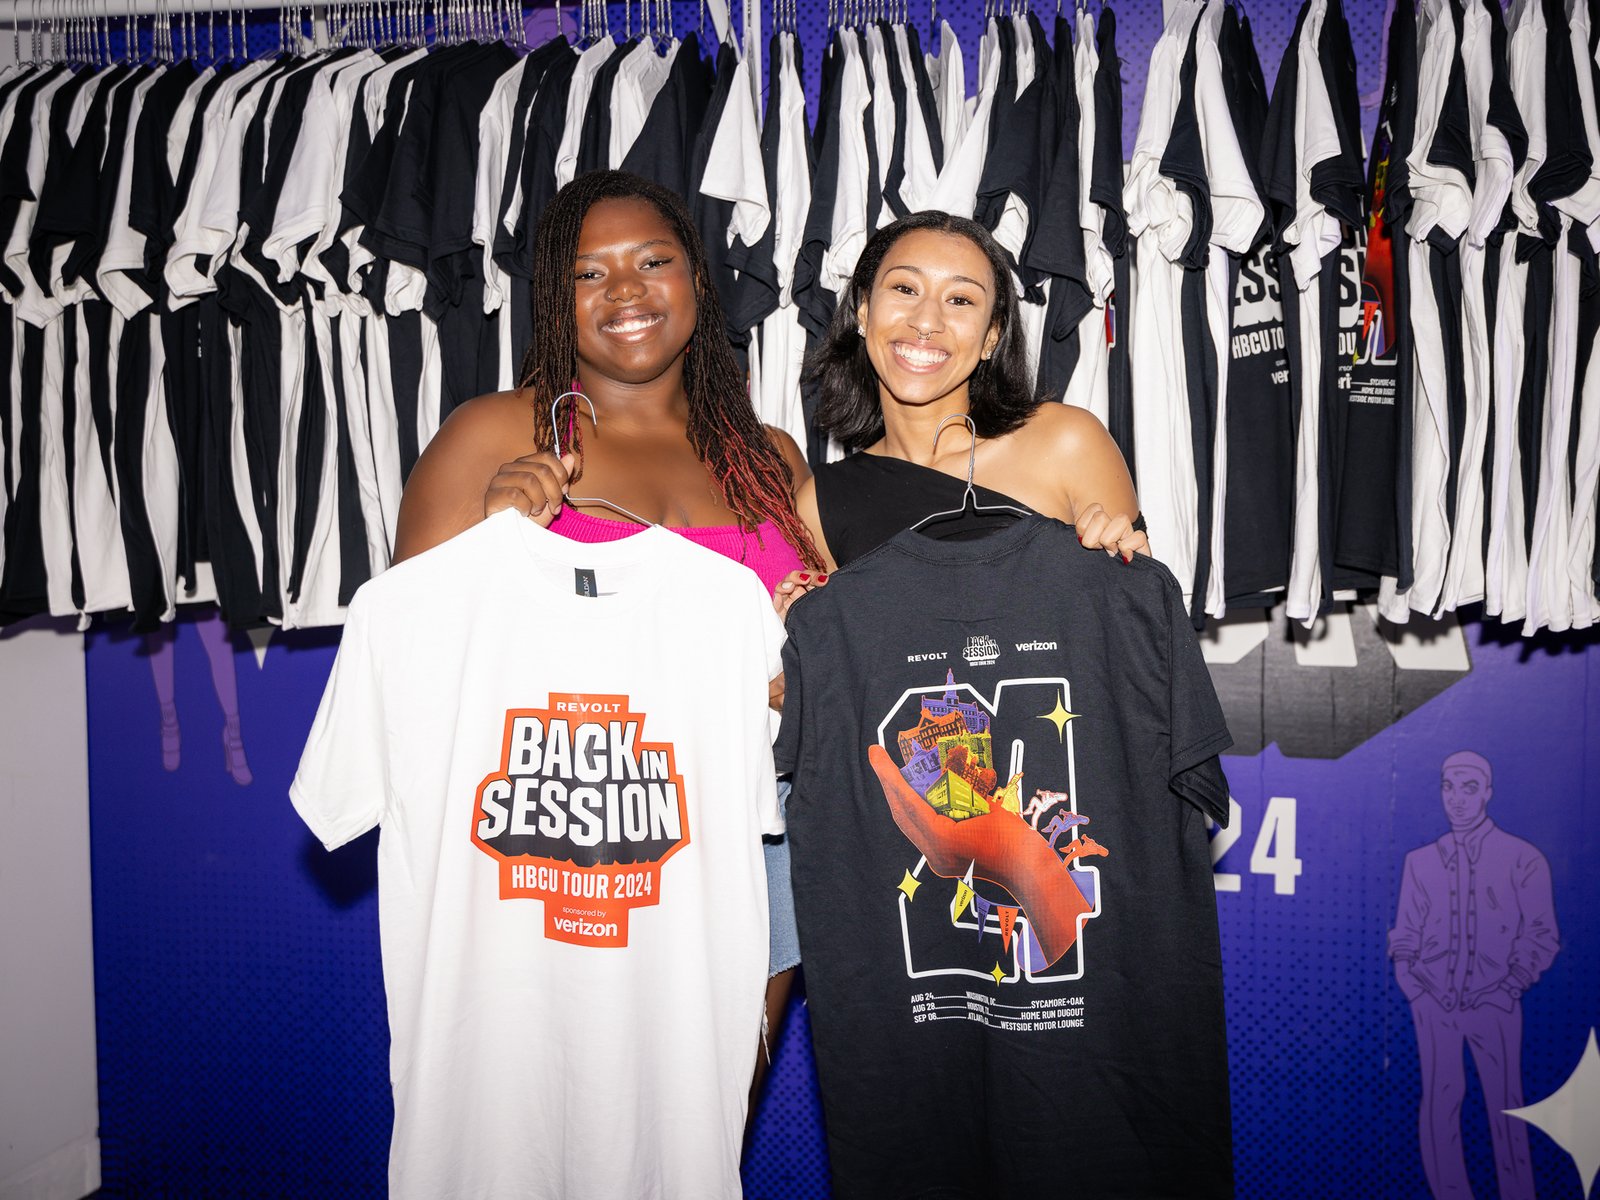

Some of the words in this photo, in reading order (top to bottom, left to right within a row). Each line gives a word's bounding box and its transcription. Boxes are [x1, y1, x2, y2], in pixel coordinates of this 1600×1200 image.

[1232, 329, 1270, 359] HBCU
[964, 645, 1000, 658] SESSION
[1015, 640, 1057, 652] verizon
[908, 652, 948, 662] REVOLT
[556, 702, 621, 713] REVOLT
[508, 716, 640, 783] BACK
[642, 750, 669, 780] IN
[477, 778, 682, 846] SESSION
[512, 865, 558, 892] HBCU
[562, 871, 609, 899] TOUR
[614, 872, 652, 899] 2024
[563, 906, 596, 916] sponsored
[597, 910, 606, 918] by
[554, 916, 618, 937] verizon
[911, 994, 924, 1003] AUG
[925, 992, 934, 1001] 24
[1031, 997, 1084, 1008] SYCAMORE+OAK
[912, 1004, 926, 1013] AUG
[927, 1002, 936, 1010] 28
[1021, 1011, 1040, 1020] HOME
[1042, 1010, 1056, 1019] RUN
[1057, 1008, 1084, 1017] DUGOUT
[914, 1014, 926, 1023] SEP
[1001, 1021, 1032, 1031] WESTSIDE
[1034, 1021, 1056, 1031] MOTOR
[1057, 1019, 1084, 1028] LOUNGE
